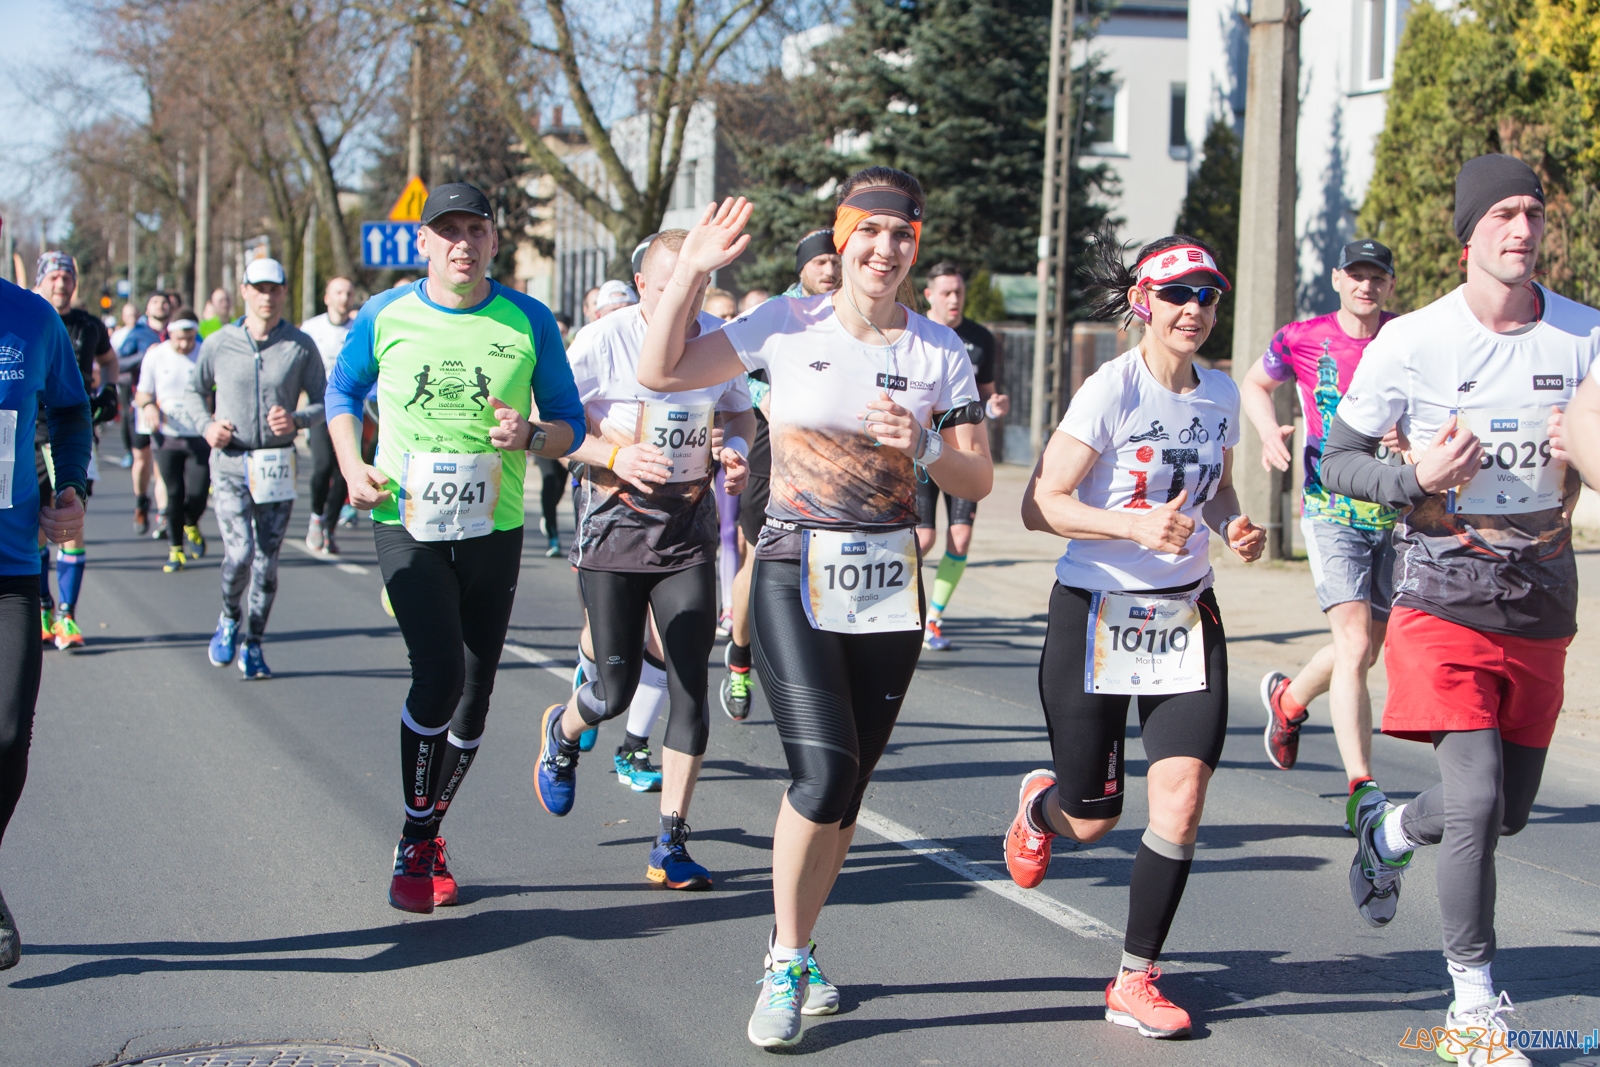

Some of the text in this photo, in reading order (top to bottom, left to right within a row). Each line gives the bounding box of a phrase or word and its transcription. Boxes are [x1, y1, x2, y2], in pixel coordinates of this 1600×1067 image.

[809, 360, 831, 371] 4F
[1457, 380, 1478, 392] 4F
[652, 426, 708, 450] 3048
[260, 464, 290, 480] 1472
[1496, 473, 1536, 483] Wojciech
[422, 481, 486, 505] 4941
[823, 560, 904, 591] 10112
[850, 593, 879, 602] Natalia
[1108, 625, 1190, 653] 10110
[1135, 656, 1163, 665] Marita
